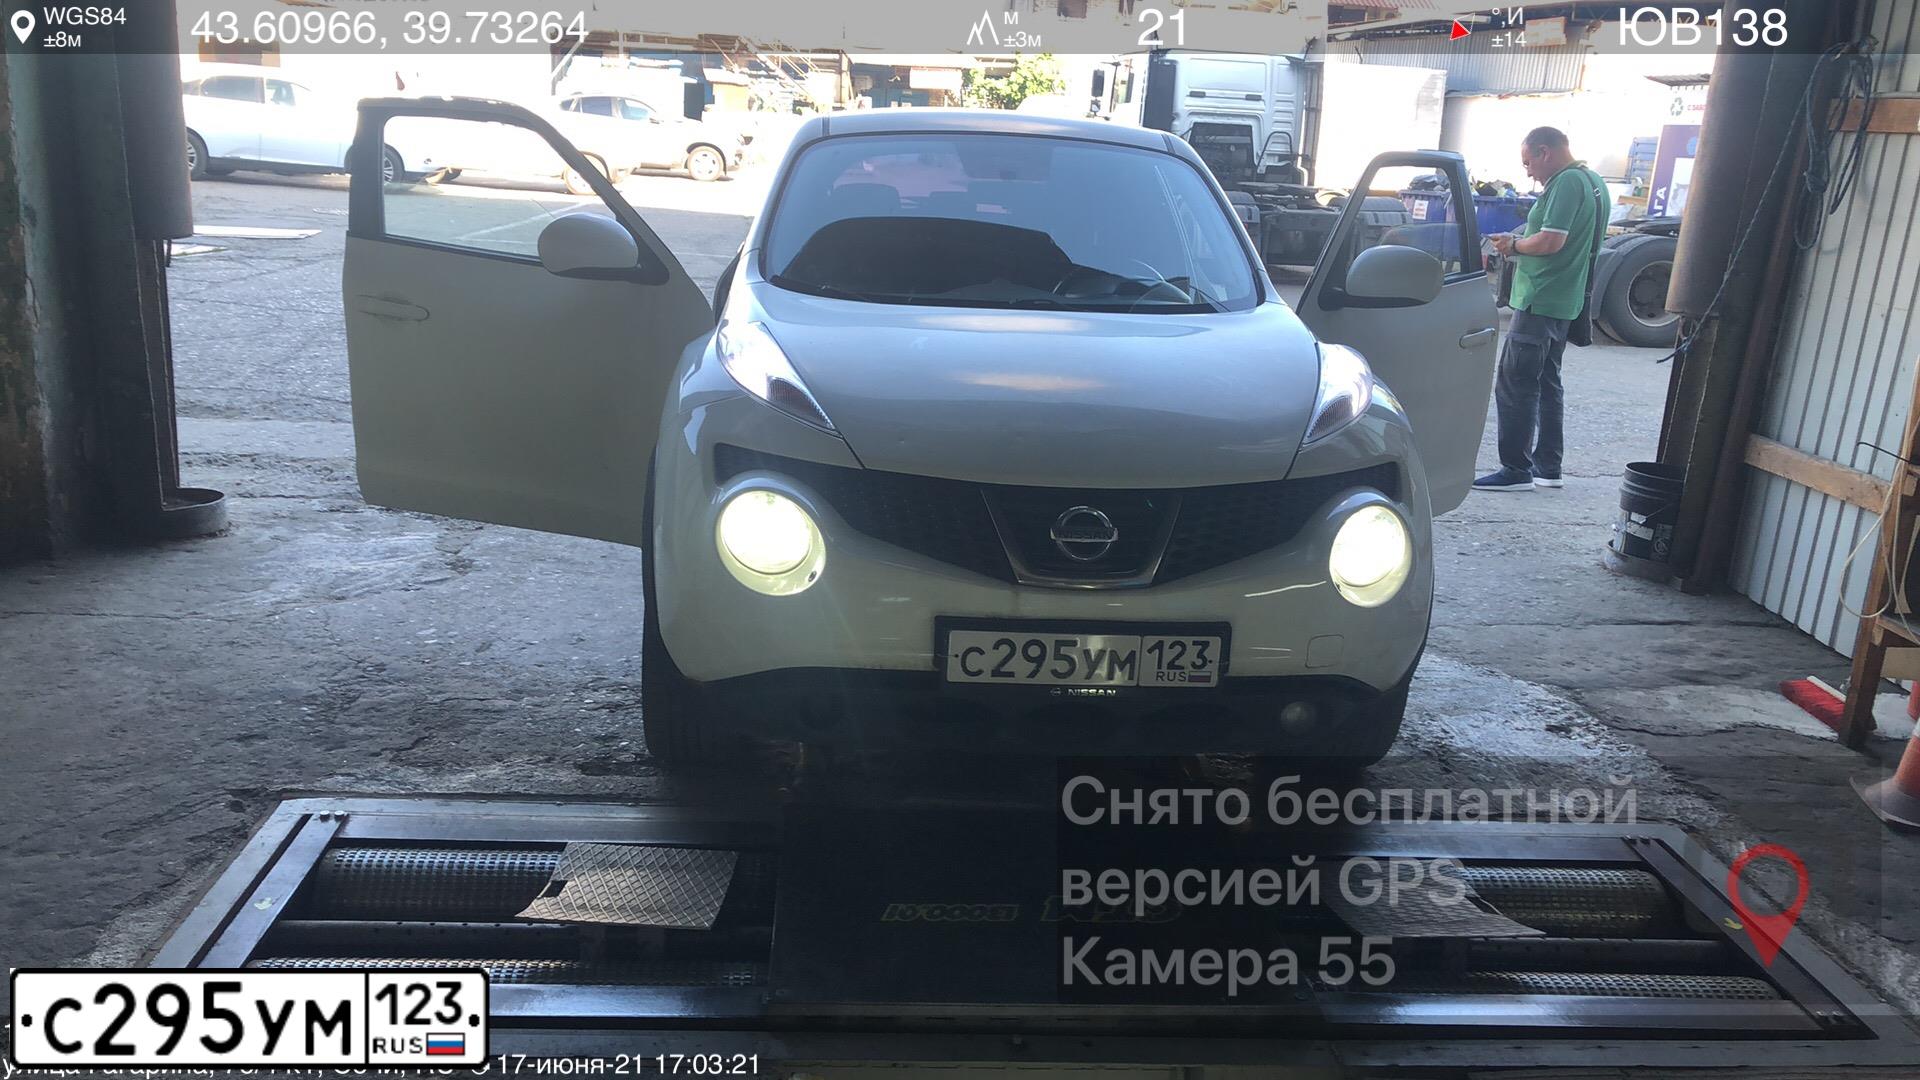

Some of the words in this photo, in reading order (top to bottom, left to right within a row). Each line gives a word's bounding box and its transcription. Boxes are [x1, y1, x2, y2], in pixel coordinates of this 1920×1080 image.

[1147, 640, 1211, 671] 123
[1156, 671, 1187, 682] RUS
[1068, 688, 1116, 697] NISSAN
